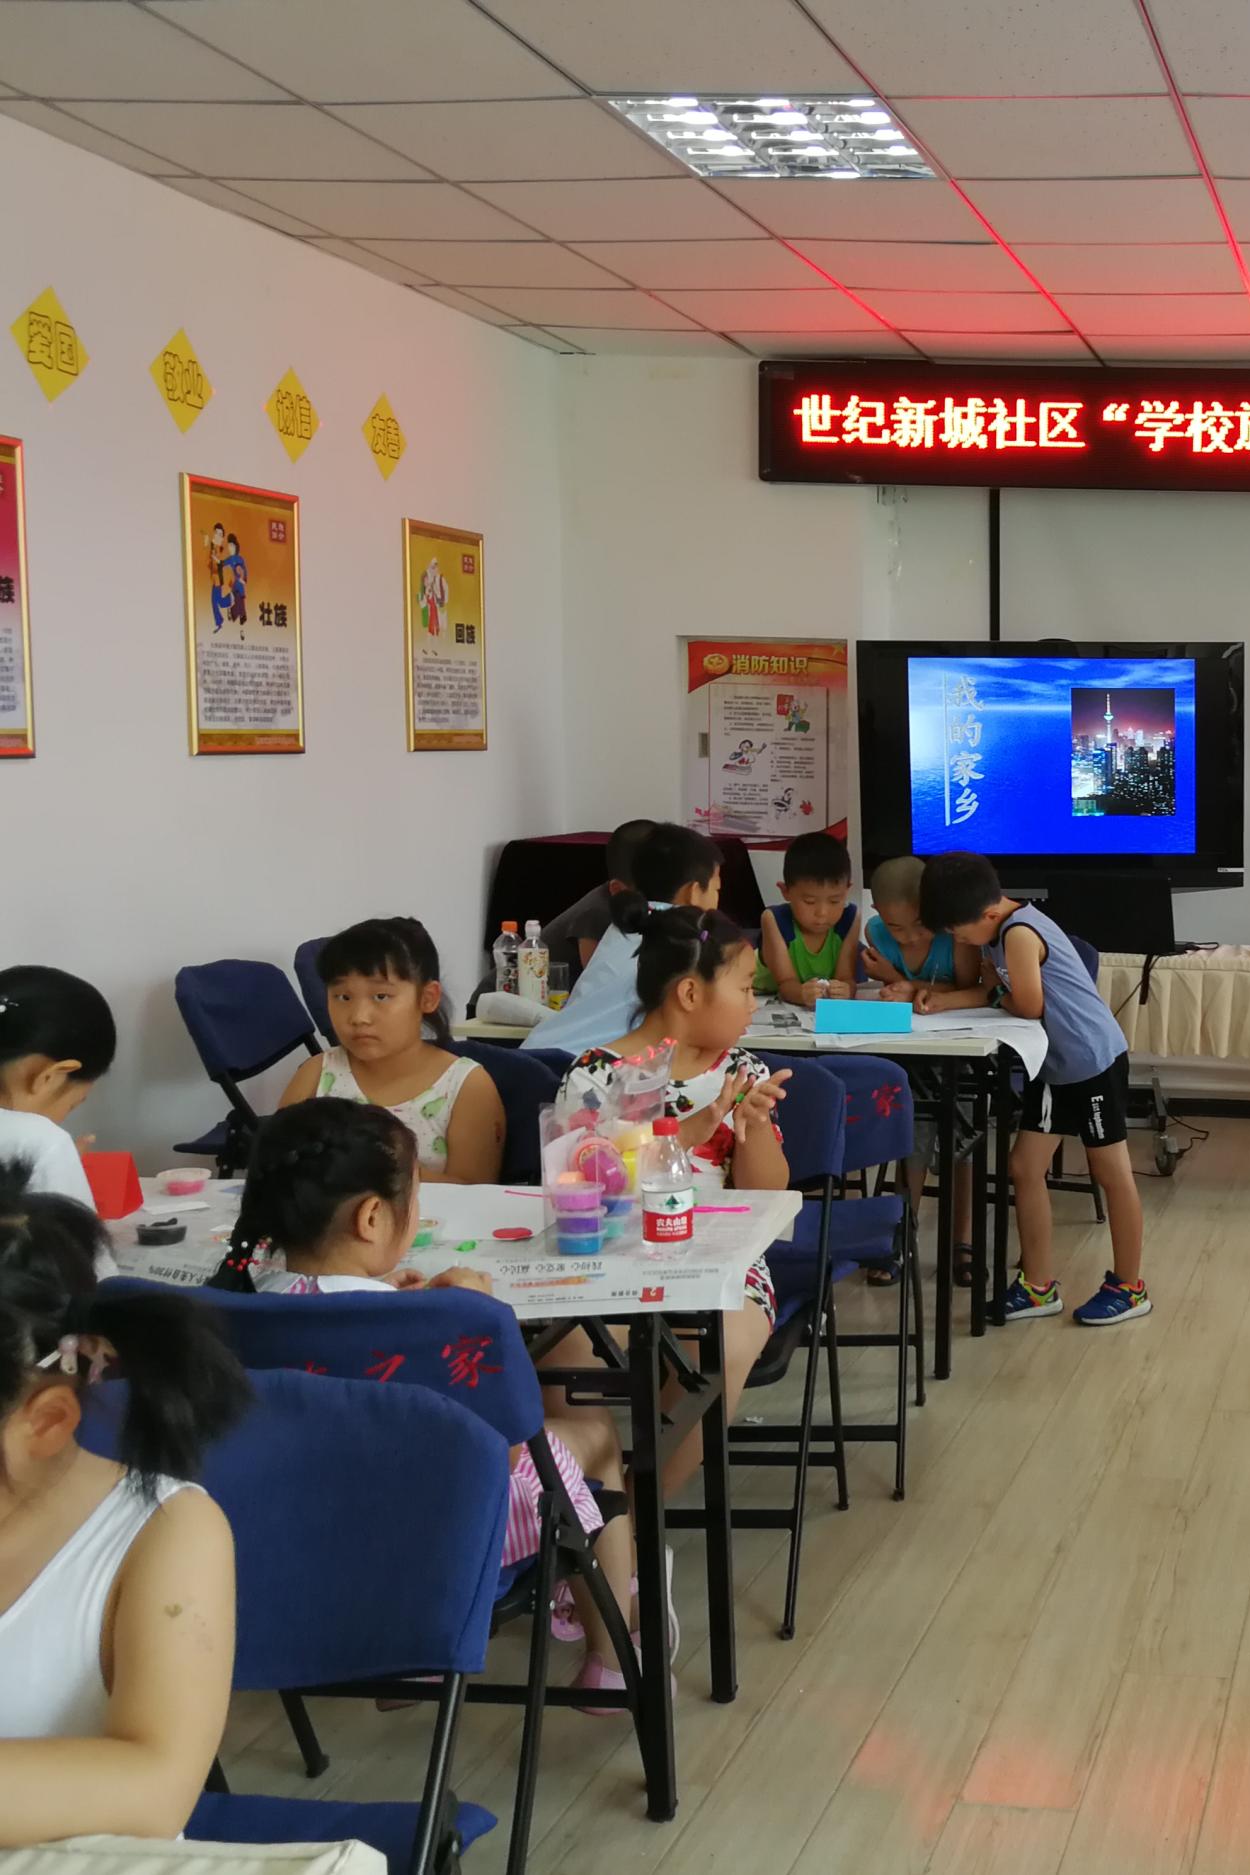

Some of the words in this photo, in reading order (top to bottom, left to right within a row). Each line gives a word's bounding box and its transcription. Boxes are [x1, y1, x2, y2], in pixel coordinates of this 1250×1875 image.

[162, 351, 204, 410] 敬业
[275, 390, 313, 440] 诚信
[371, 413, 400, 460] 友善
[258, 600, 288, 628] 壮族
[731, 654, 809, 676] 消防知识
[950, 675, 985, 826] 我的家乡
